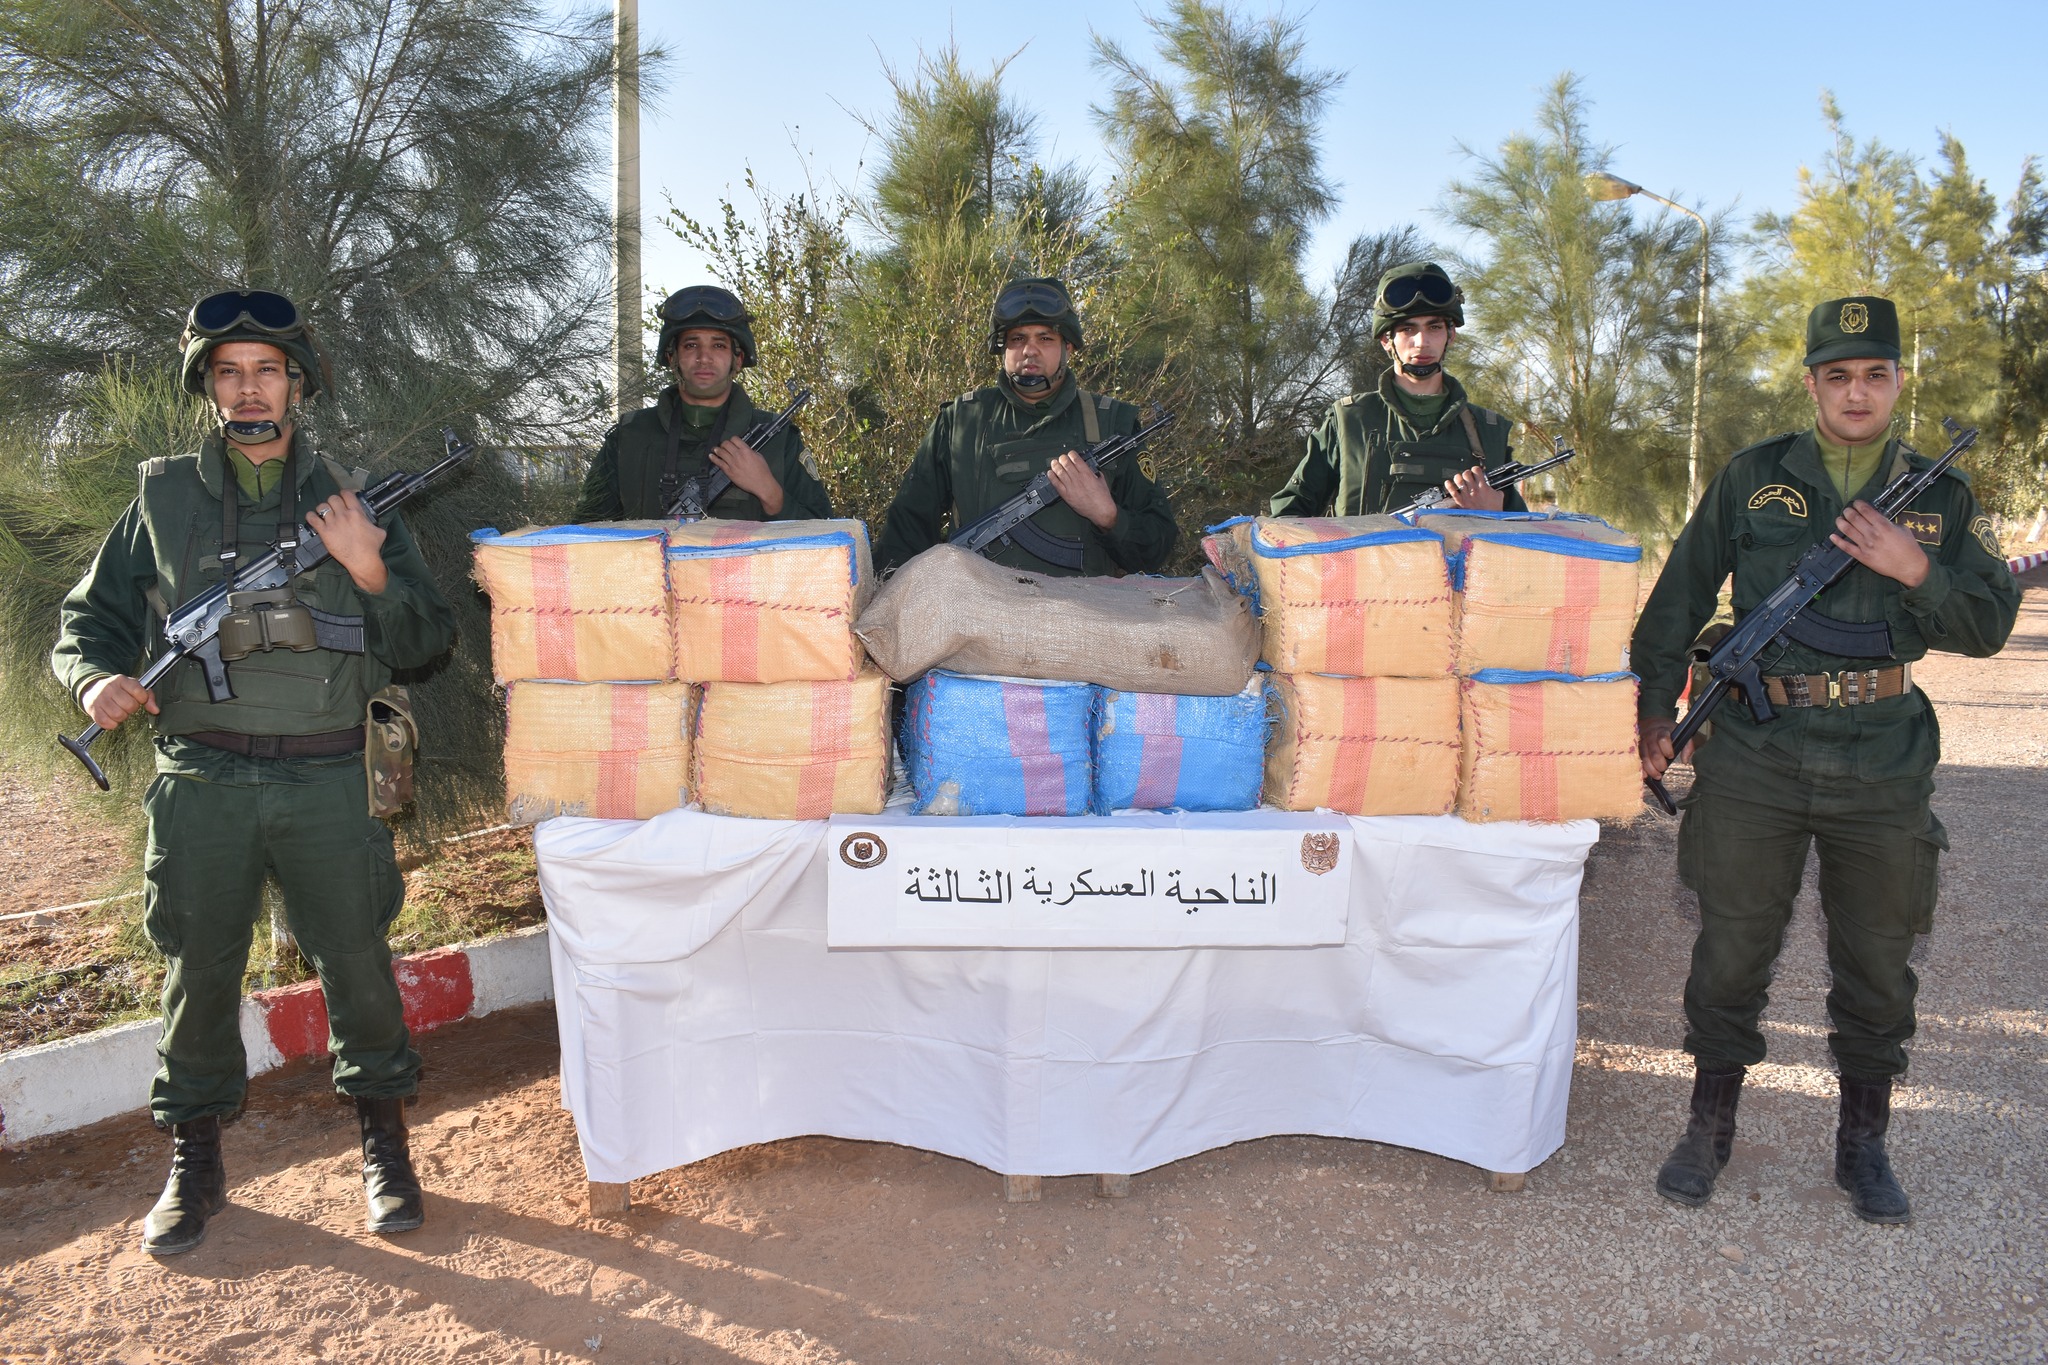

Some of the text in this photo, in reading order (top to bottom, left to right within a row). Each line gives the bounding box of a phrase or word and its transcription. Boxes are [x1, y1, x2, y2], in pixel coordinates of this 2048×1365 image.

[904, 866, 1277, 916] الناحية العسكرية الثالثة
